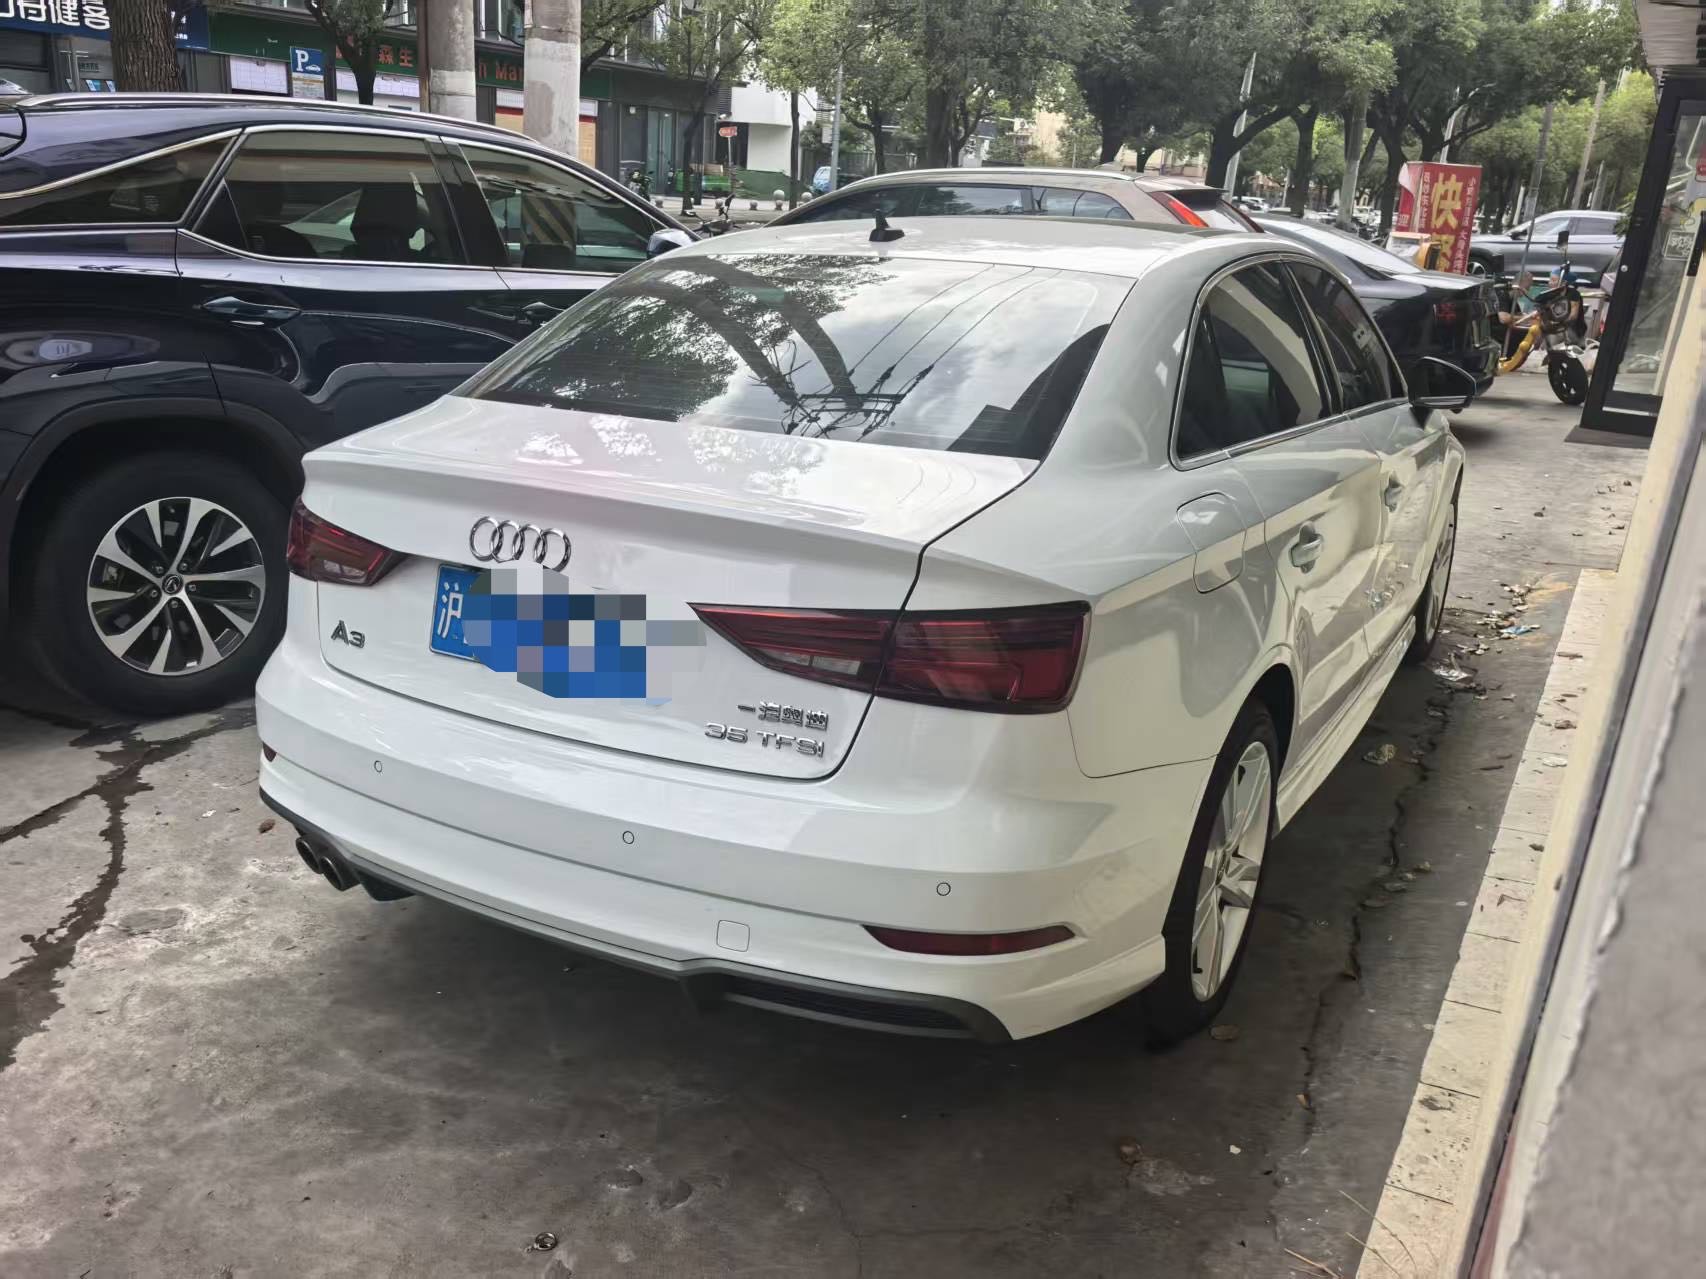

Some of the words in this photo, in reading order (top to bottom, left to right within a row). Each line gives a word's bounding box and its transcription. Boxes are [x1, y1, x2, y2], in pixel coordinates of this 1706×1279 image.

[295, 49, 309, 72] P
[331, 620, 366, 648] A3
[704, 722, 748, 744] 35
[756, 731, 825, 758] TFSI
